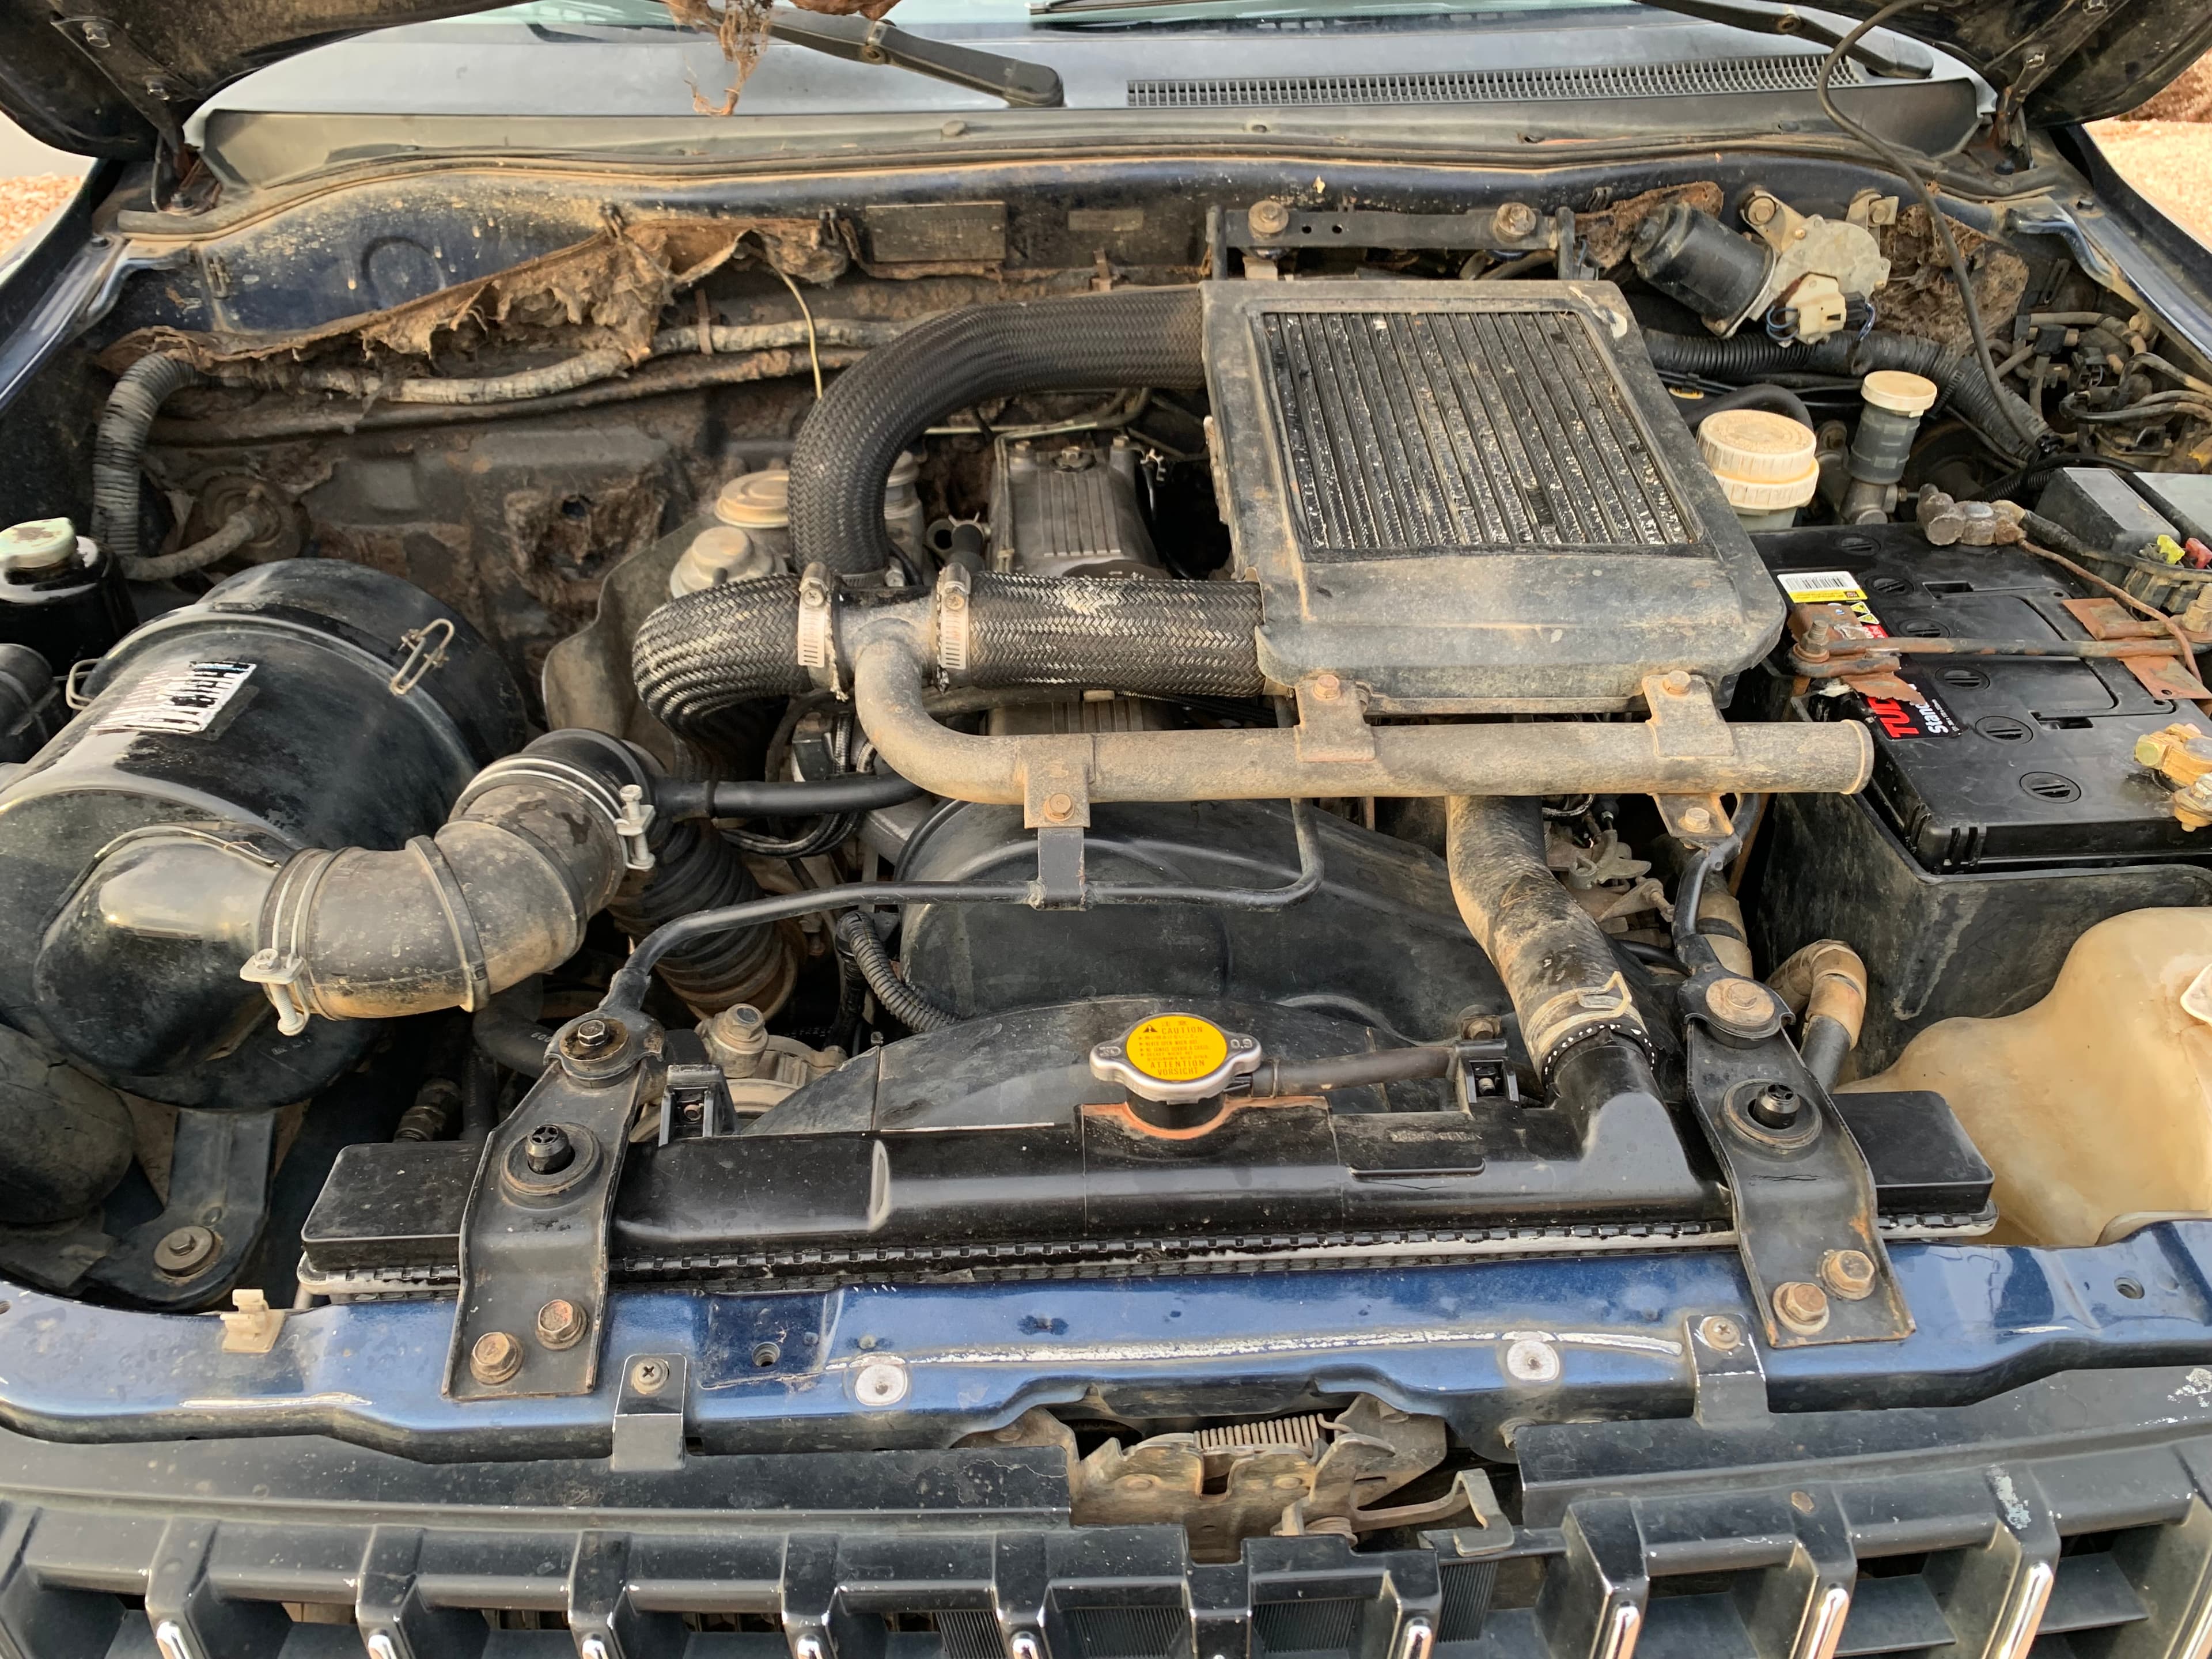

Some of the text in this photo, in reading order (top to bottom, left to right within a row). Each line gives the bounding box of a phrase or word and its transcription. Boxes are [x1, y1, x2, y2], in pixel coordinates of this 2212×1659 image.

[1161, 1027, 1203, 1035] CAUTION
[1230, 1038, 1253, 1049] 0.9
[1150, 1059, 1205, 1069] ATTENTION
[1158, 1067, 1199, 1075] VORSICHT
